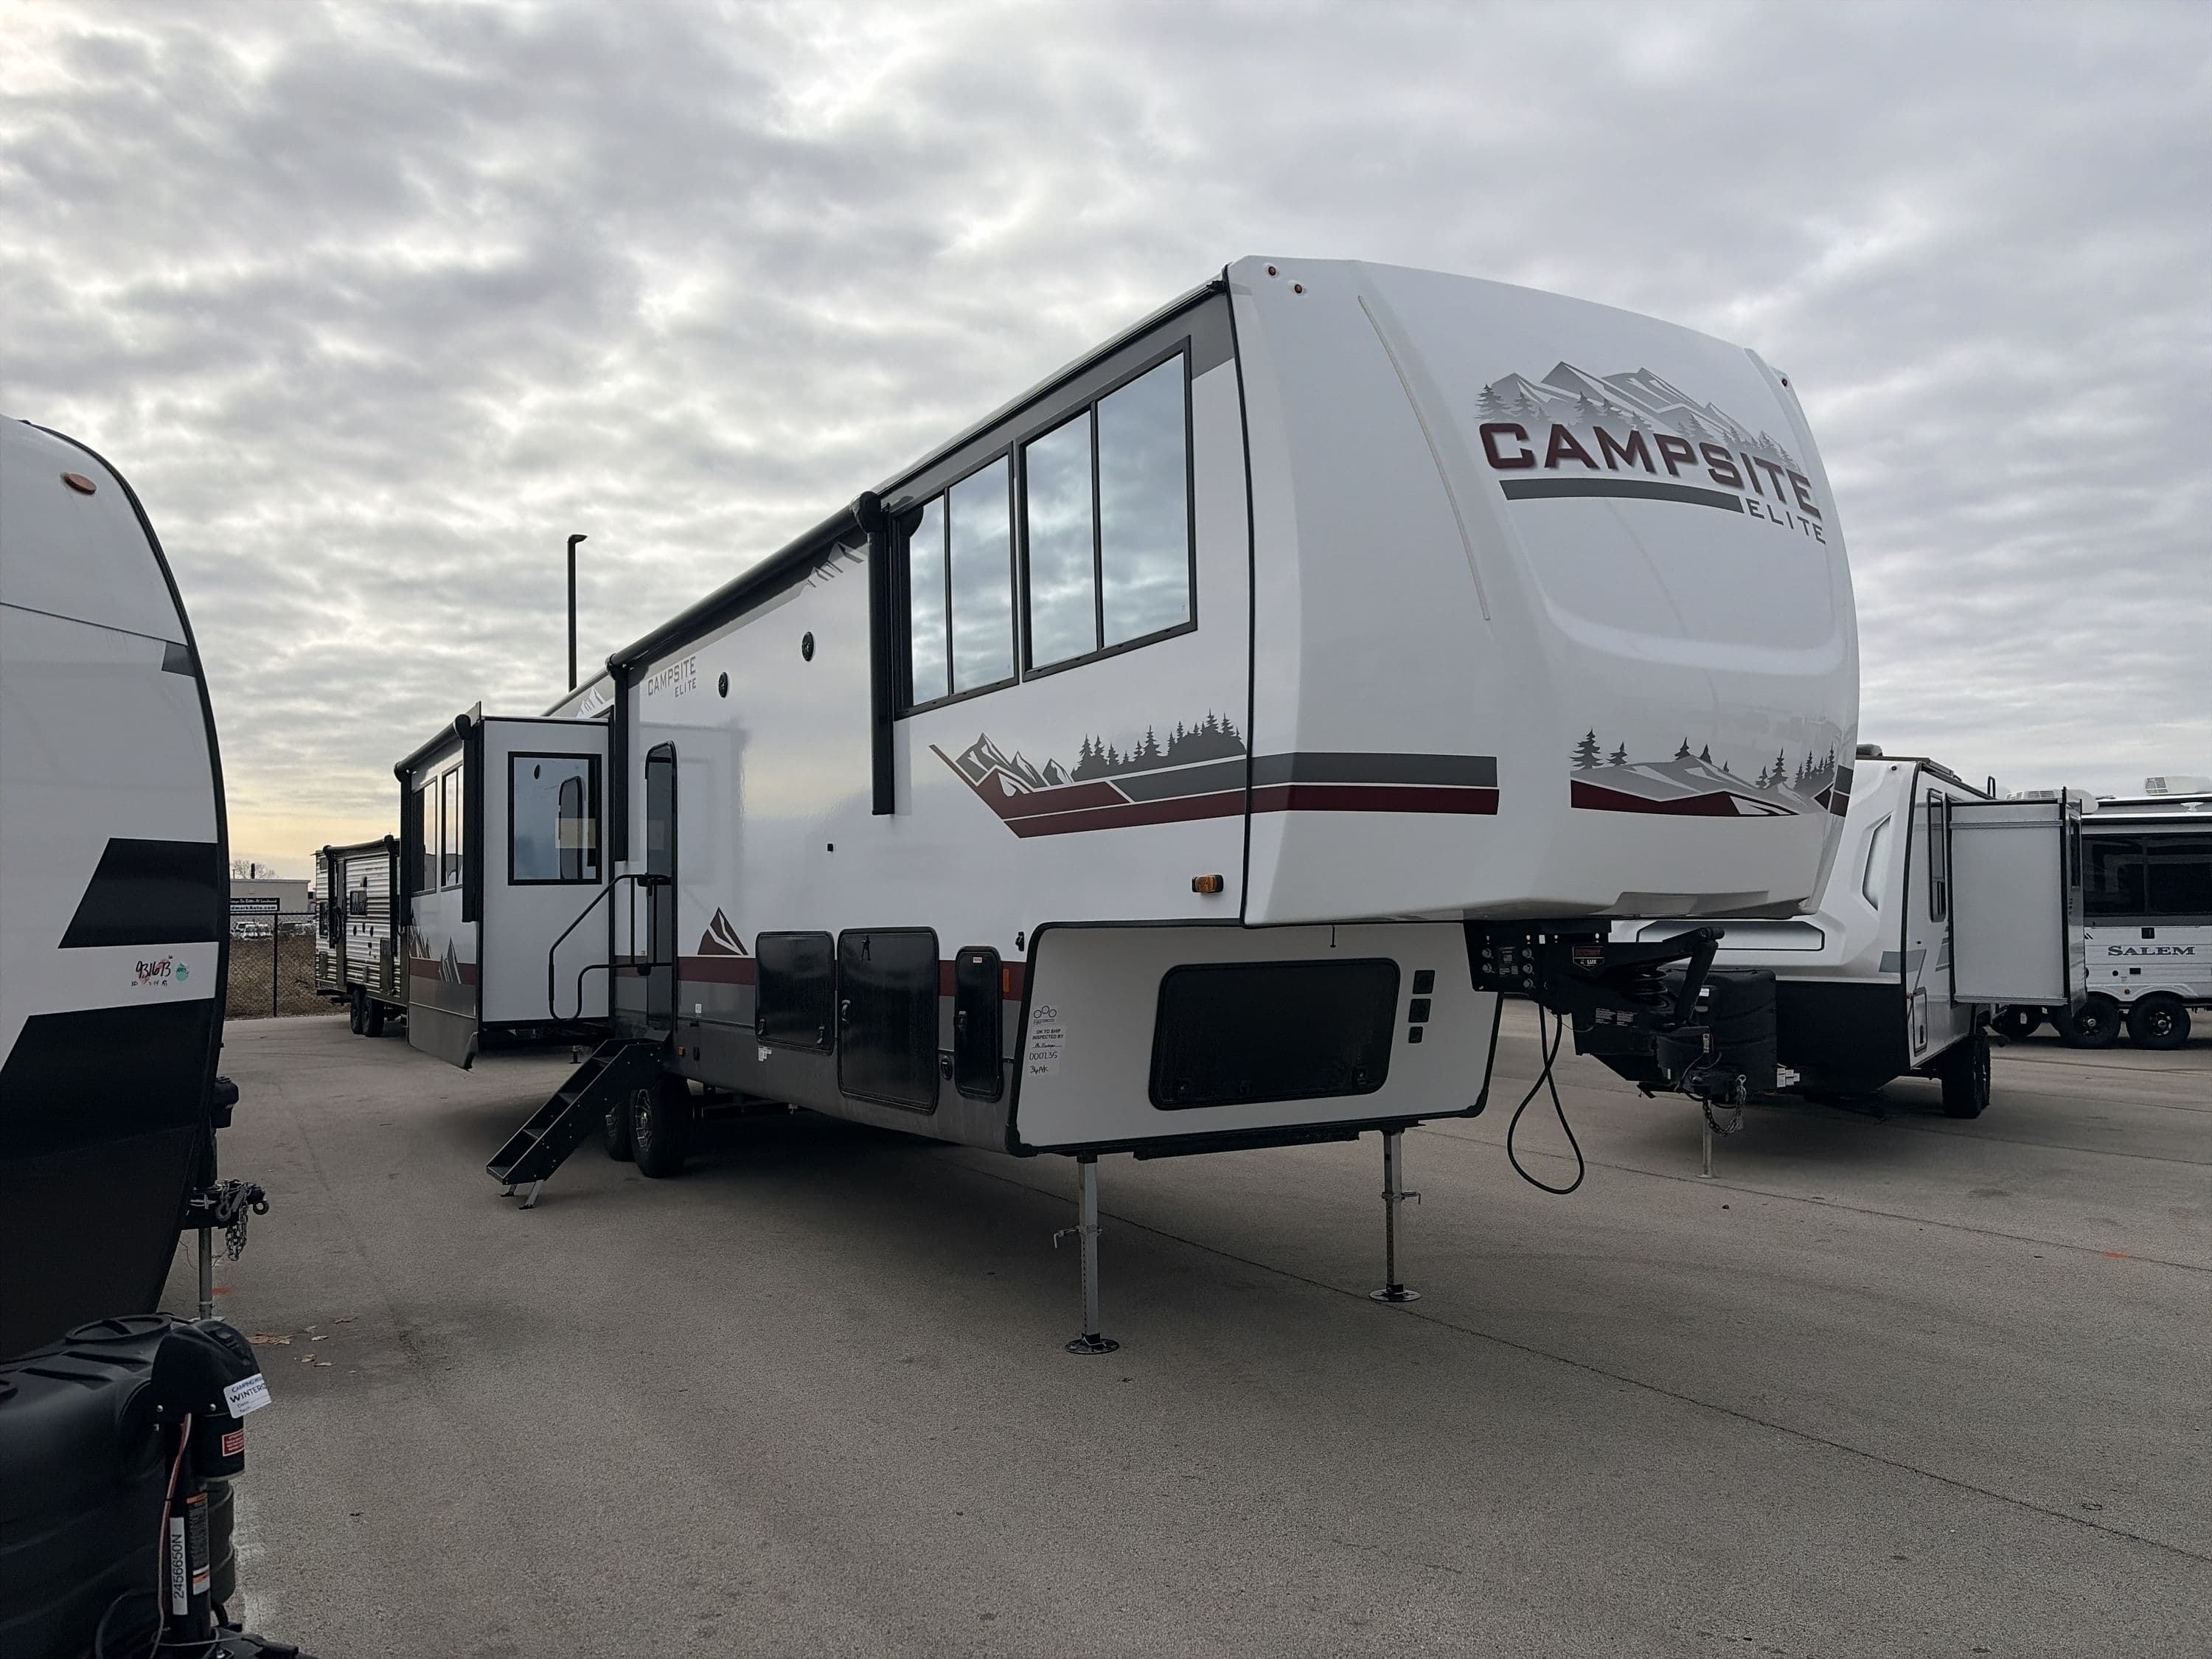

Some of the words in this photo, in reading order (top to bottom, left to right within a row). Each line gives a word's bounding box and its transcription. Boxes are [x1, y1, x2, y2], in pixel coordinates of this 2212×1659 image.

[1478, 422, 1823, 520] CAMPSITE
[1745, 498, 1826, 545] ELITE
[647, 655, 696, 697] CAMPSITE
[675, 677, 697, 698] ELITE
[2107, 945, 2196, 956] SALEM
